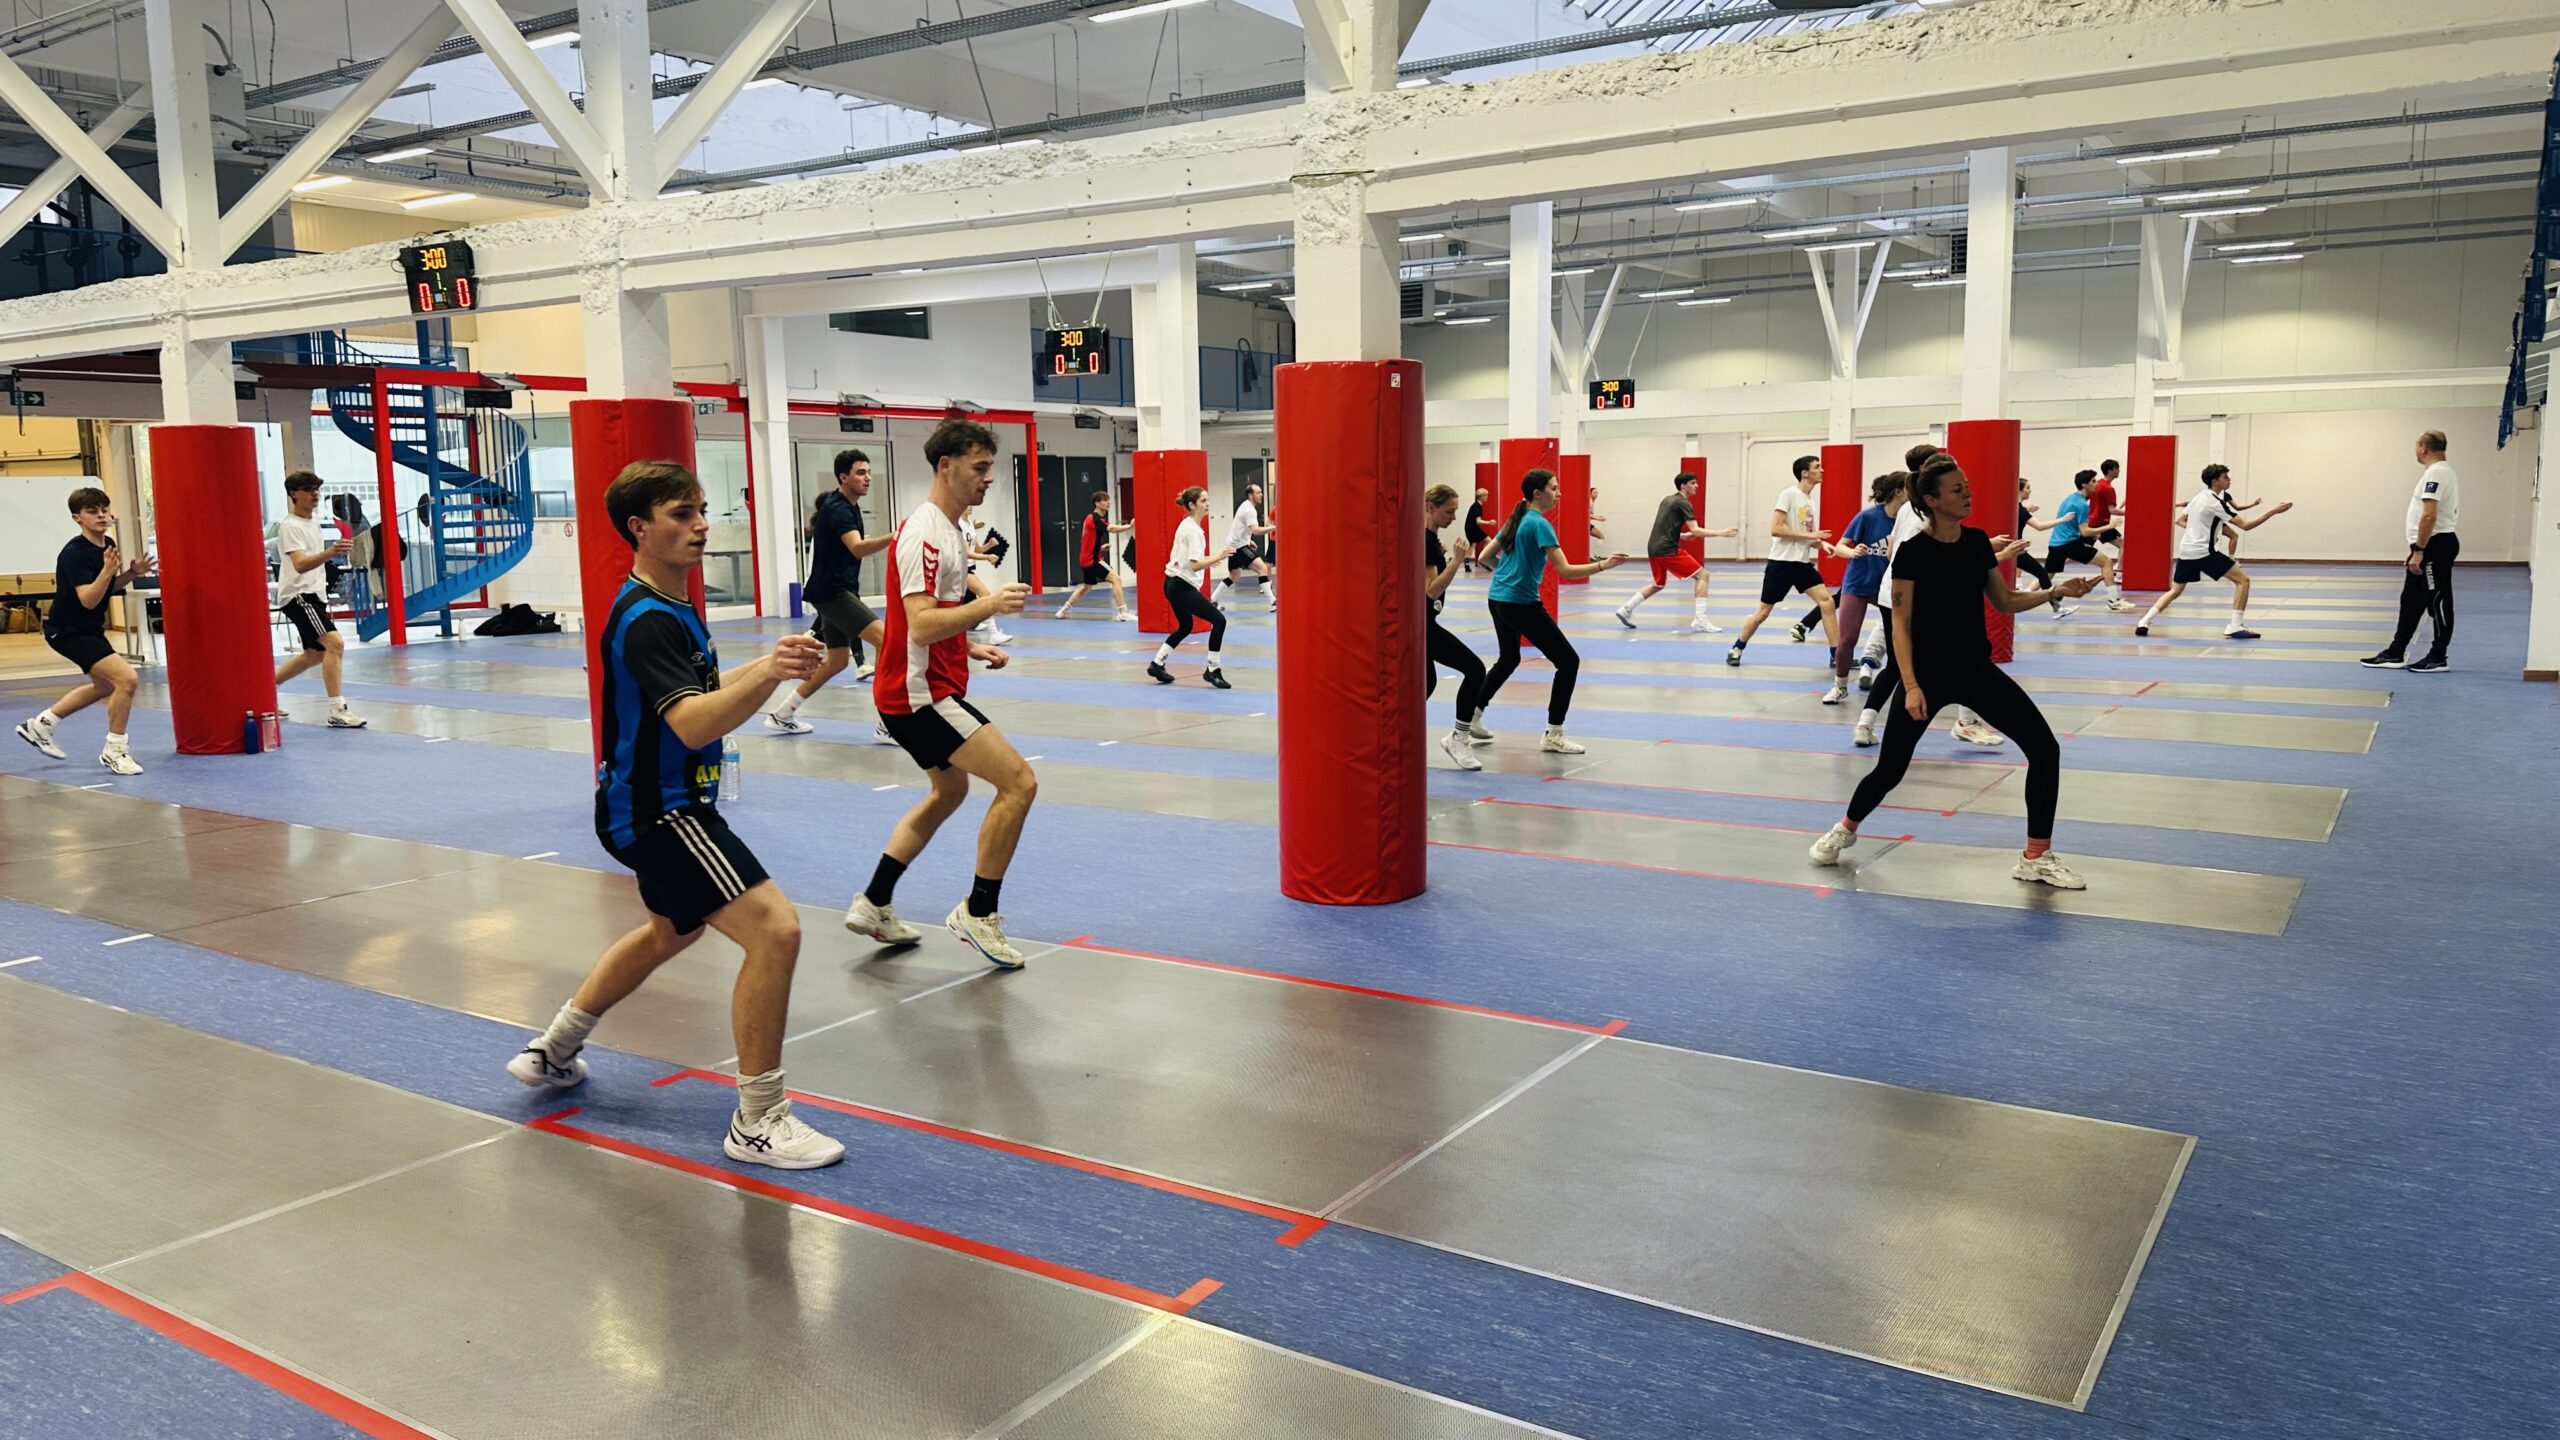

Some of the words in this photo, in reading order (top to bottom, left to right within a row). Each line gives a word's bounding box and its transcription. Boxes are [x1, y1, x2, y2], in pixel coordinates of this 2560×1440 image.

[420, 247, 447, 271] 3:00
[418, 282, 433, 312] 0
[456, 278, 471, 307] 0
[1060, 331, 1083, 347] 3:00
[1055, 354, 1065, 375] 0
[1089, 352, 1099, 373] 0
[1602, 381, 1619, 392] 3:00
[1597, 395, 1604, 409] 0
[1623, 394, 1630, 408] 0
